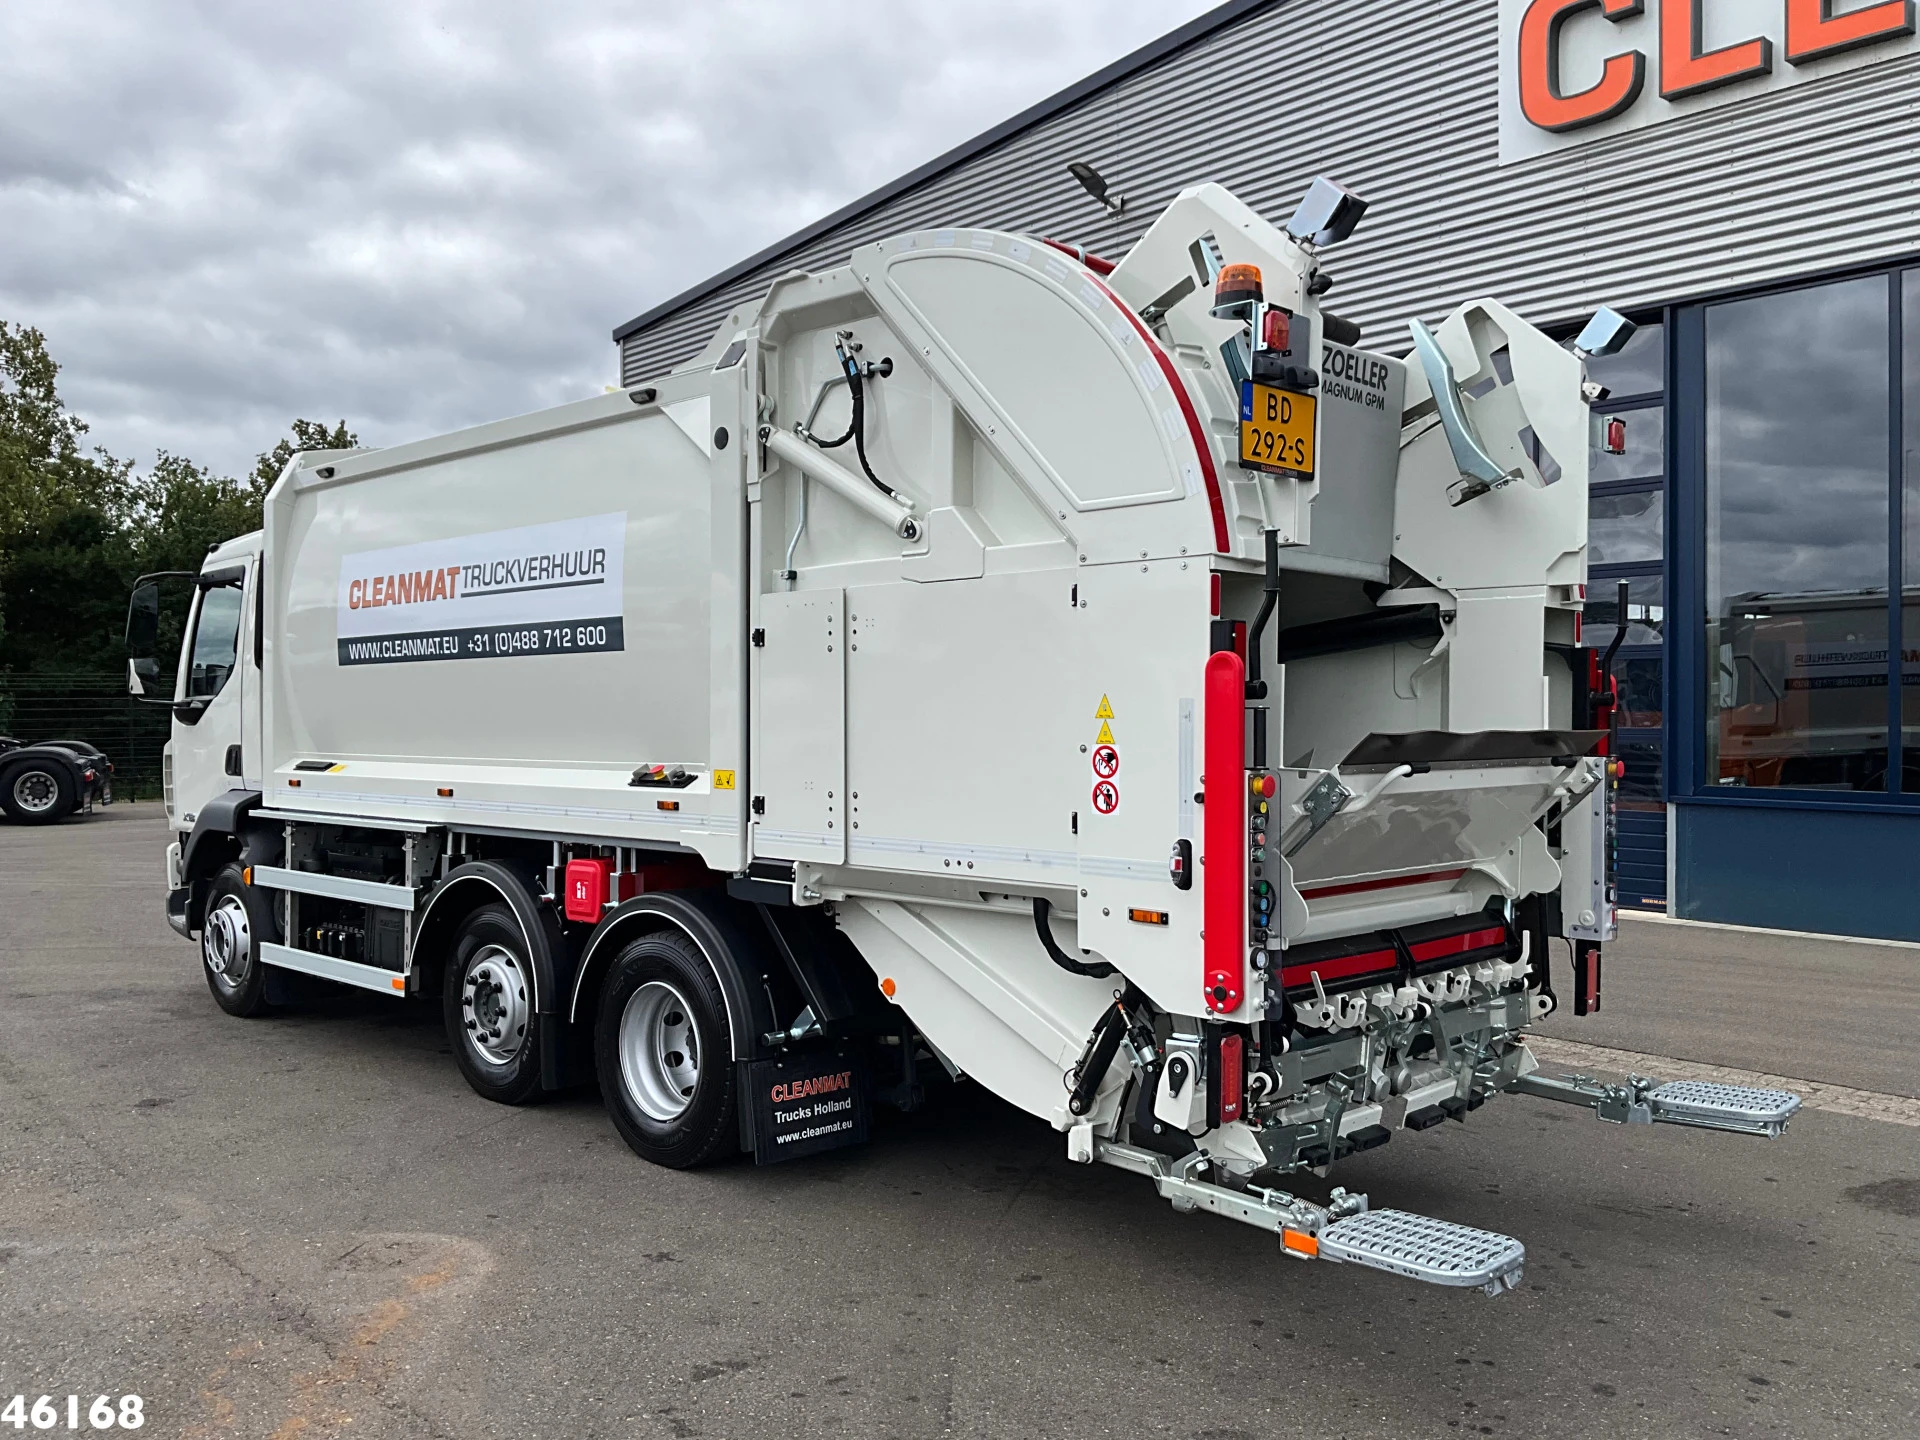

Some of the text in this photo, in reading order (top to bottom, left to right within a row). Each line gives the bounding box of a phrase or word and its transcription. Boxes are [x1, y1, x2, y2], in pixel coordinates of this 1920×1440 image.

[1322, 345, 1388, 391] ZOELLER
[1242, 405, 1252, 416] NL
[1267, 393, 1292, 425] BD
[1365, 392, 1385, 411] GPM
[1251, 428, 1305, 466] 292-S
[349, 548, 606, 610] CLEANMAT TRUCKVERHUUR
[349, 625, 607, 660] WWW.CLEANMAT.EU +31 (0)488 712 600
[771, 1072, 852, 1103] CLEANMAT
[774, 1097, 852, 1124] Trucks Holland
[776, 1120, 853, 1145] www.cleanmat.eu
